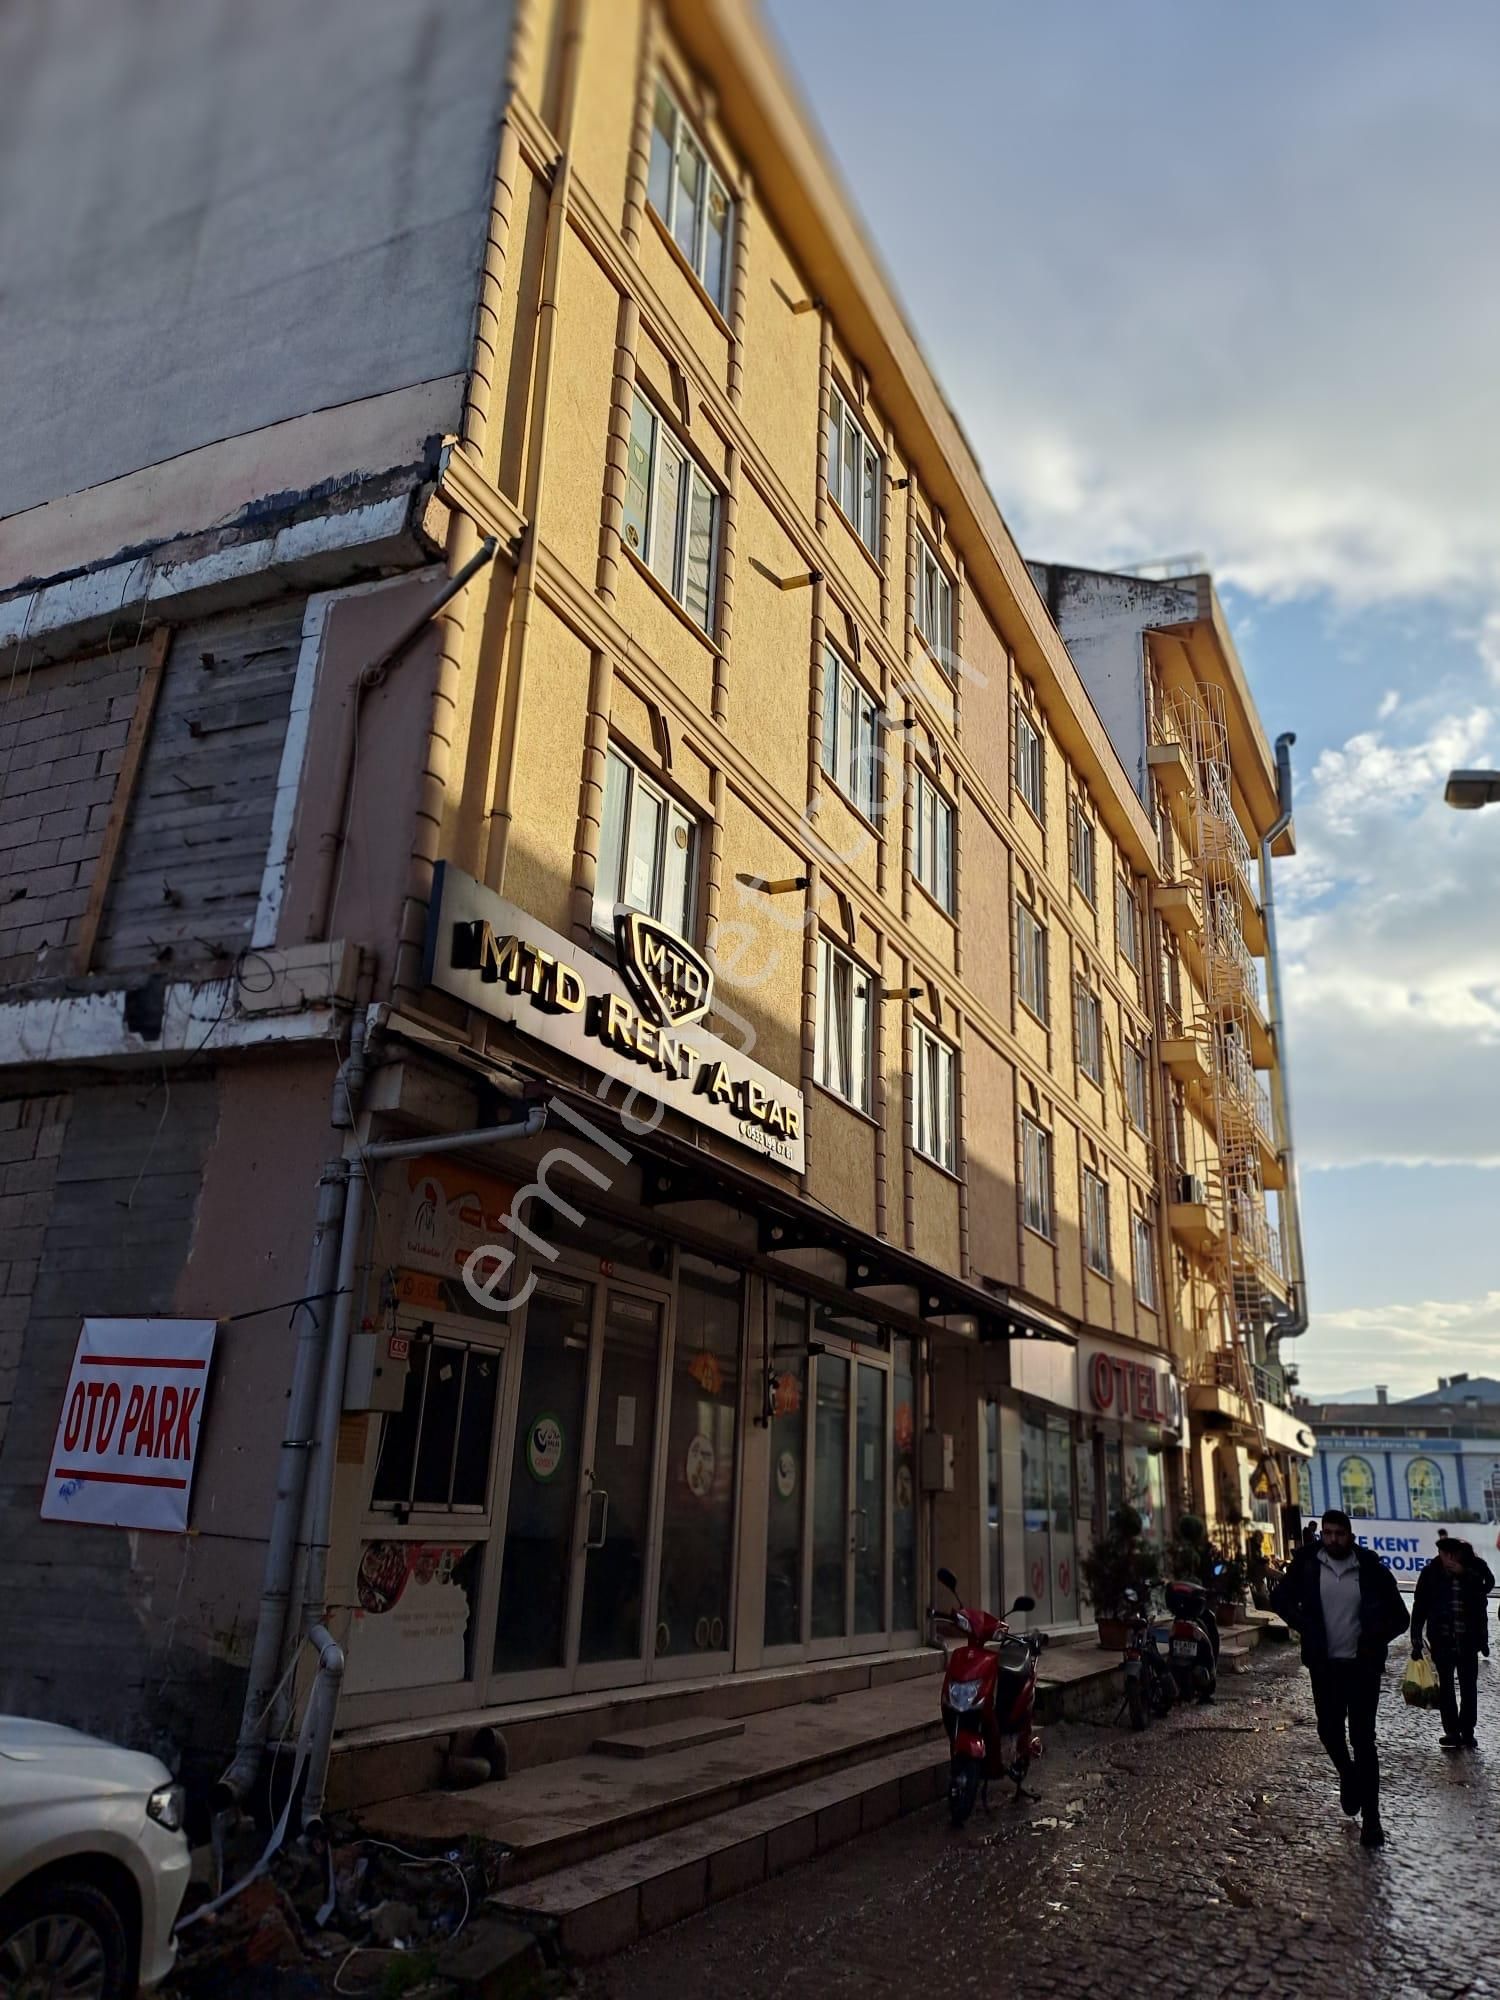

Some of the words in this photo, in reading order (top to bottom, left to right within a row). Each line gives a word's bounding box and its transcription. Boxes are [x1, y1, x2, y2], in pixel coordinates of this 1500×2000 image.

[643, 932, 703, 999] MTD
[480, 919, 587, 1013] MTD
[607, 993, 699, 1080] RENT
[710, 1060, 735, 1103] A
[748, 1079, 800, 1140] CAR
[63, 1380, 121, 1455] OTO
[117, 1384, 201, 1461] PARK
[1090, 1351, 1168, 1424] OTEL
[1373, 1536, 1420, 1553] KENT
